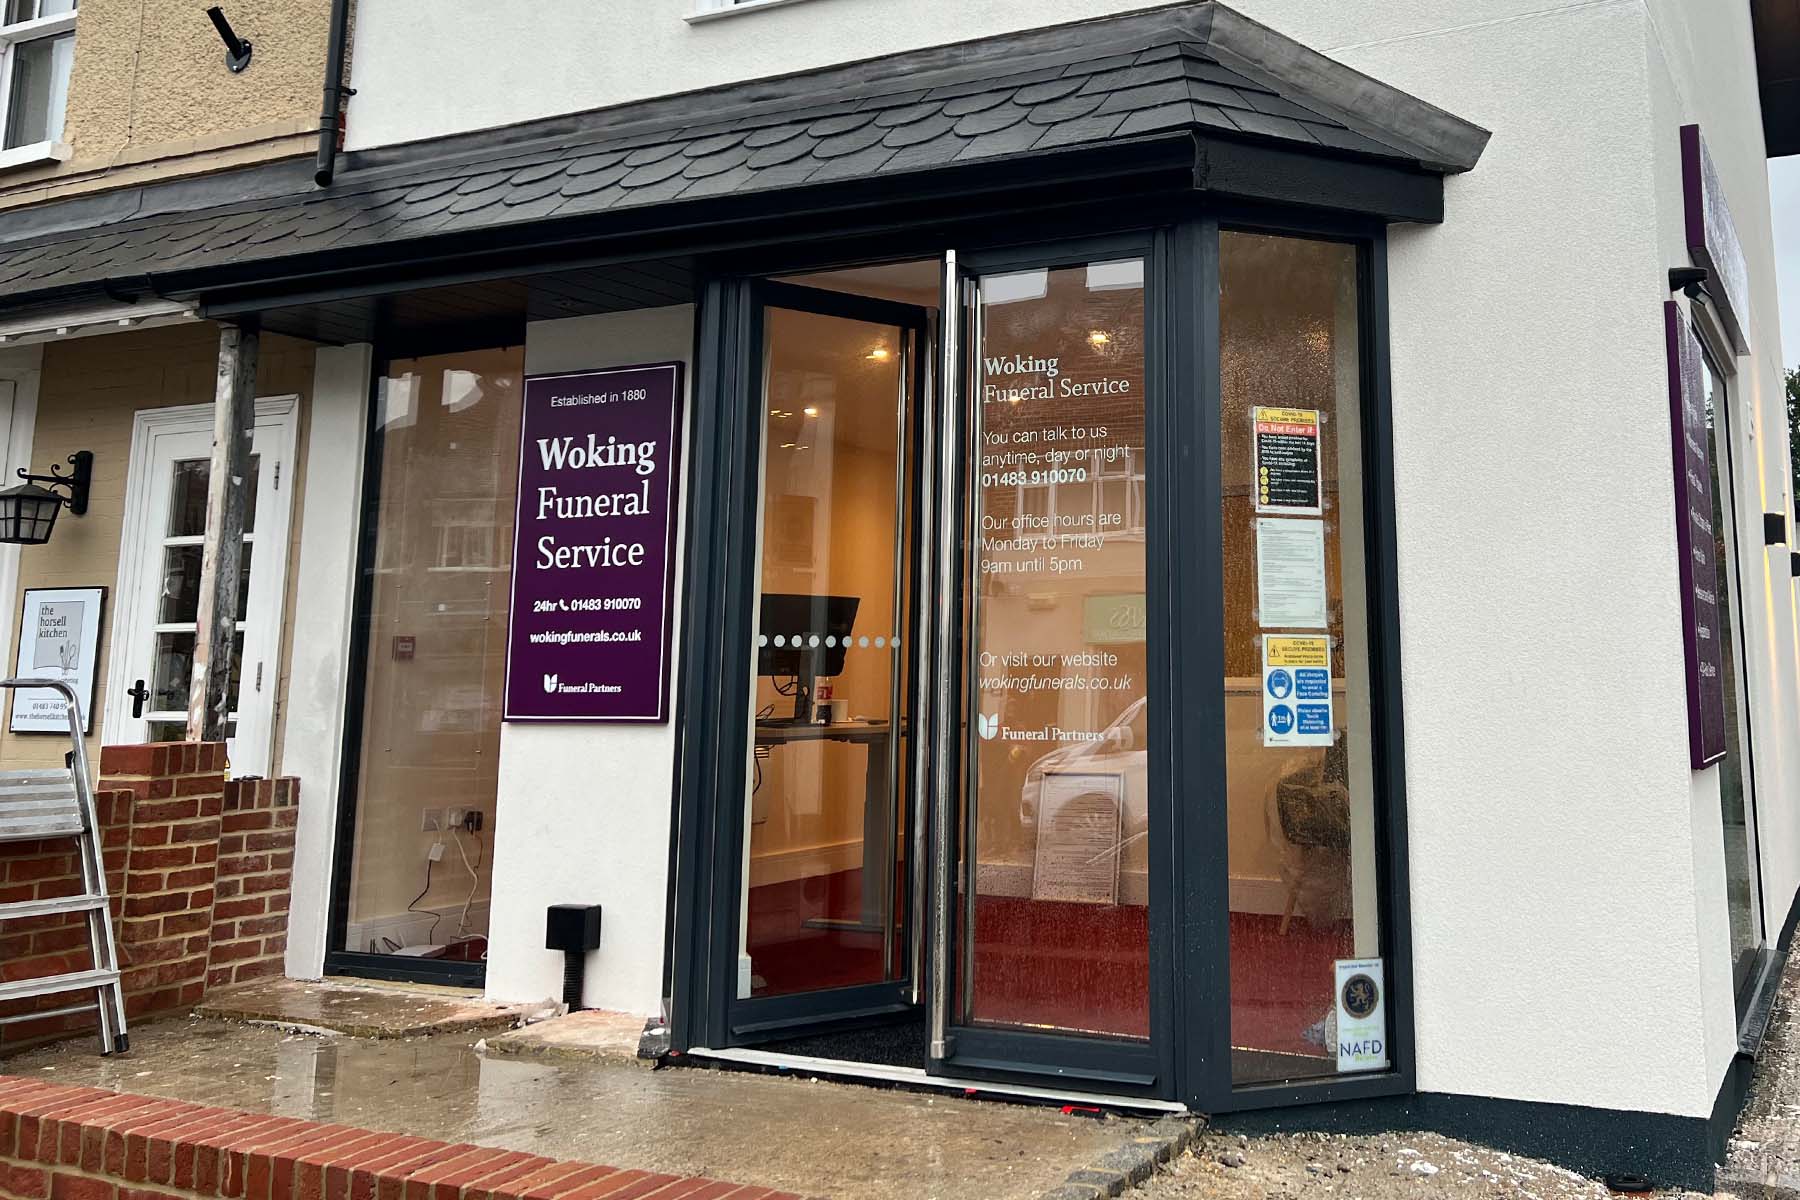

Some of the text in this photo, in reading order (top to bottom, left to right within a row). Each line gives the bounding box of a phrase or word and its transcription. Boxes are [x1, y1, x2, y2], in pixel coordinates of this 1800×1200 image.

[984, 354, 1059, 377] Woking
[551, 388, 647, 408] Established in 1880
[983, 377, 1130, 404] Funeral Service
[983, 426, 1108, 445] You can talk to us
[1258, 423, 1269, 431] Do
[1271, 424, 1284, 432] Not
[1286, 425, 1306, 433] Enter
[536, 433, 657, 476] Woking
[982, 443, 1131, 468] anytime, day or night
[982, 467, 1087, 487] 01483 910070
[536, 479, 650, 520] Funeral
[982, 511, 1122, 530] Our office hours are
[981, 533, 1105, 552] Monday to Friday
[536, 536, 645, 570] Service
[981, 556, 1083, 574] 9am until 5pm
[41, 604, 54, 616] the
[533, 597, 642, 613] 24hr 01483 910070
[39, 616, 67, 628] horsell
[38, 627, 68, 639] kitchen
[529, 629, 642, 646] wokingfunerals.co.uk
[979, 651, 1118, 667] Or visit our website
[557, 682, 622, 694] Funeral Partners
[978, 673, 1133, 693] wokingfunerals.co.uk
[1001, 726, 1105, 742] Funeral Partners
[1340, 1039, 1383, 1057] NAFD
